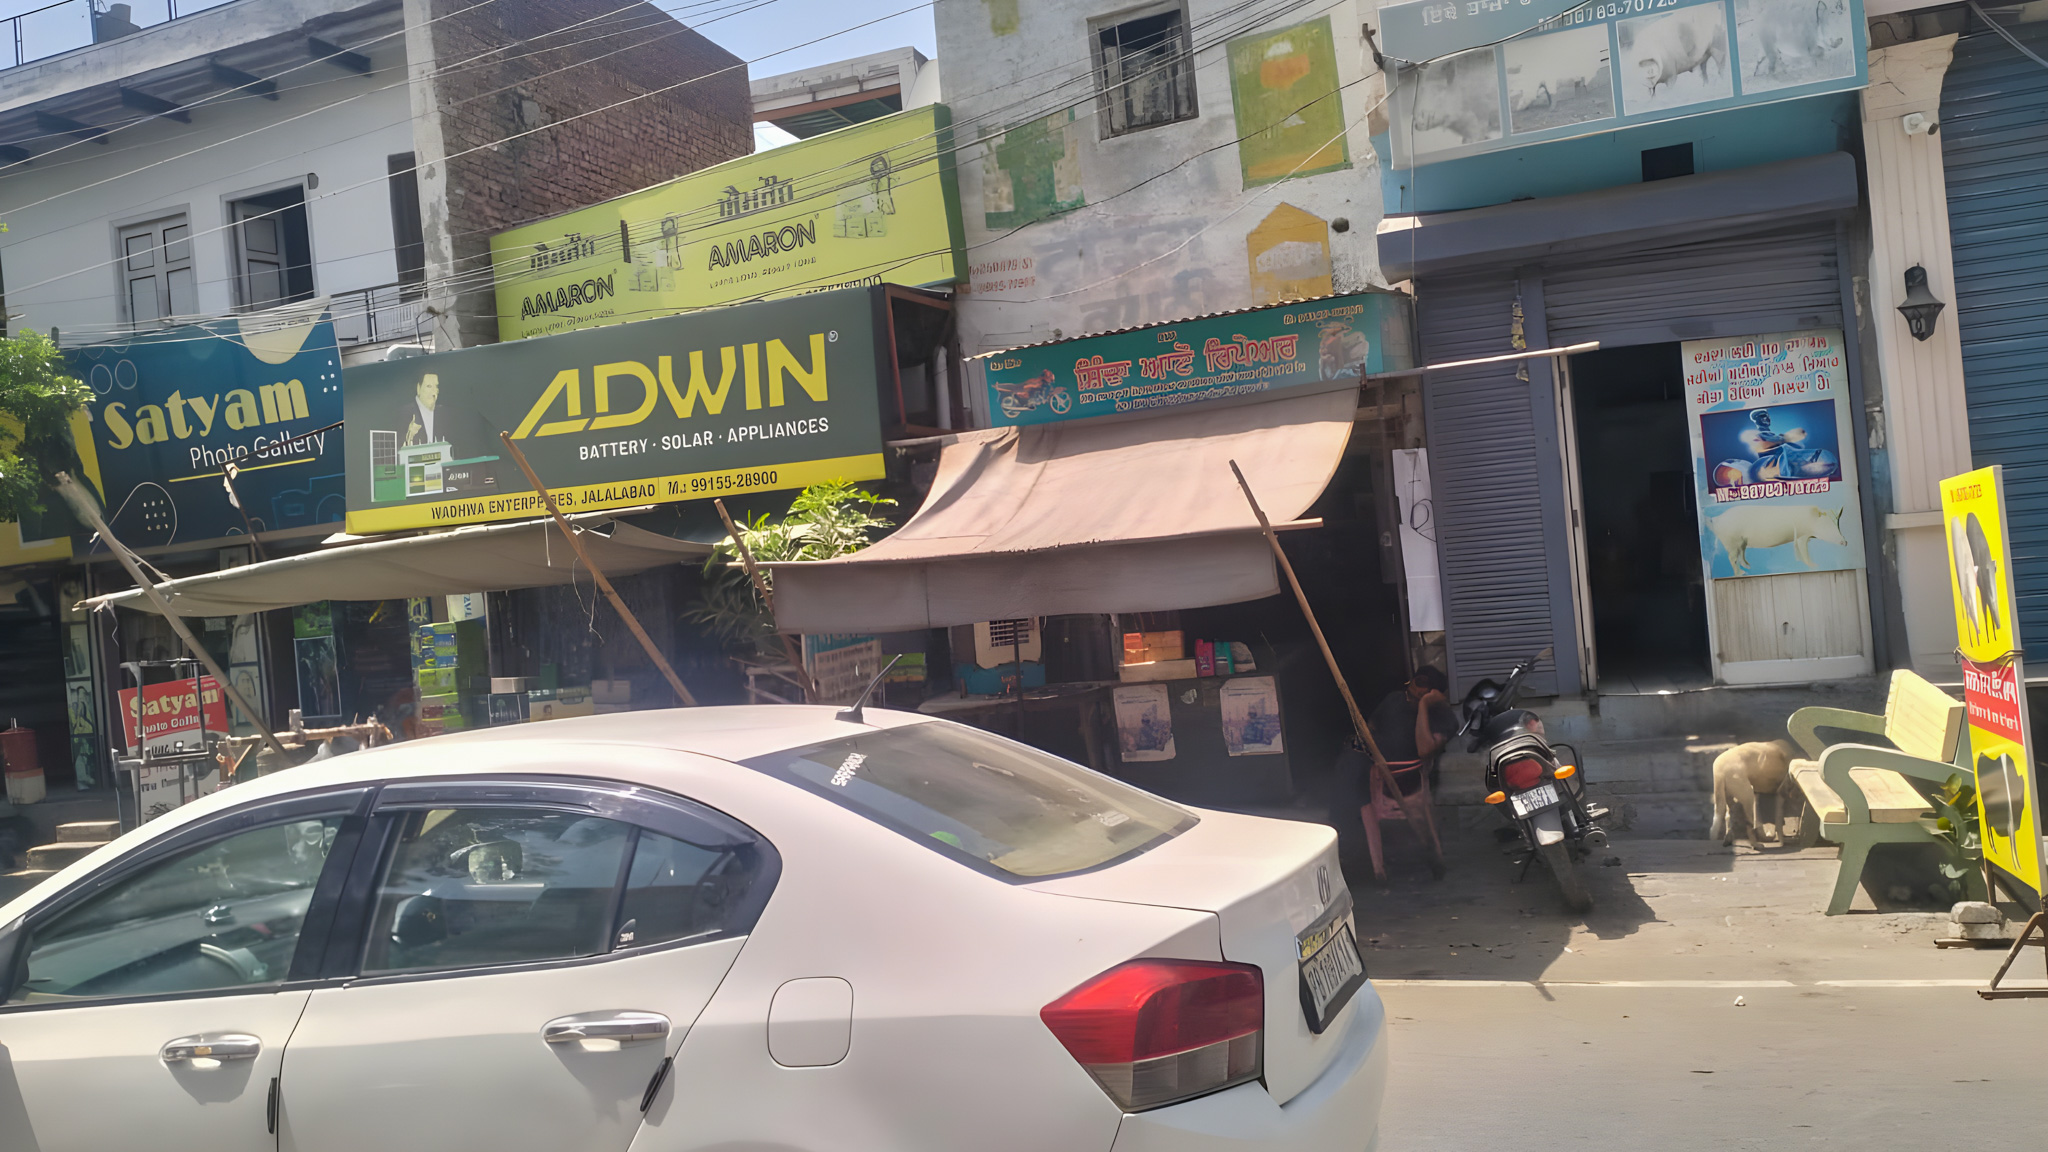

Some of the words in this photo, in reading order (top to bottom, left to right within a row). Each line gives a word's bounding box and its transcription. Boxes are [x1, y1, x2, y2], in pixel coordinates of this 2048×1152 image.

[708, 219, 816, 271] AMARON
[521, 274, 615, 321] AMARON
[513, 332, 828, 440] ADWIN
[103, 378, 310, 449] Satyam
[190, 443, 248, 469] Photo
[254, 431, 325, 459] Gallery
[579, 438, 648, 461] BATTERY
[661, 430, 714, 451] SOLAR
[727, 417, 829, 443] APPLIANCES
[431, 502, 485, 520] WADHWA
[581, 483, 656, 504] JALALABAD
[129, 689, 218, 718] Satyam
